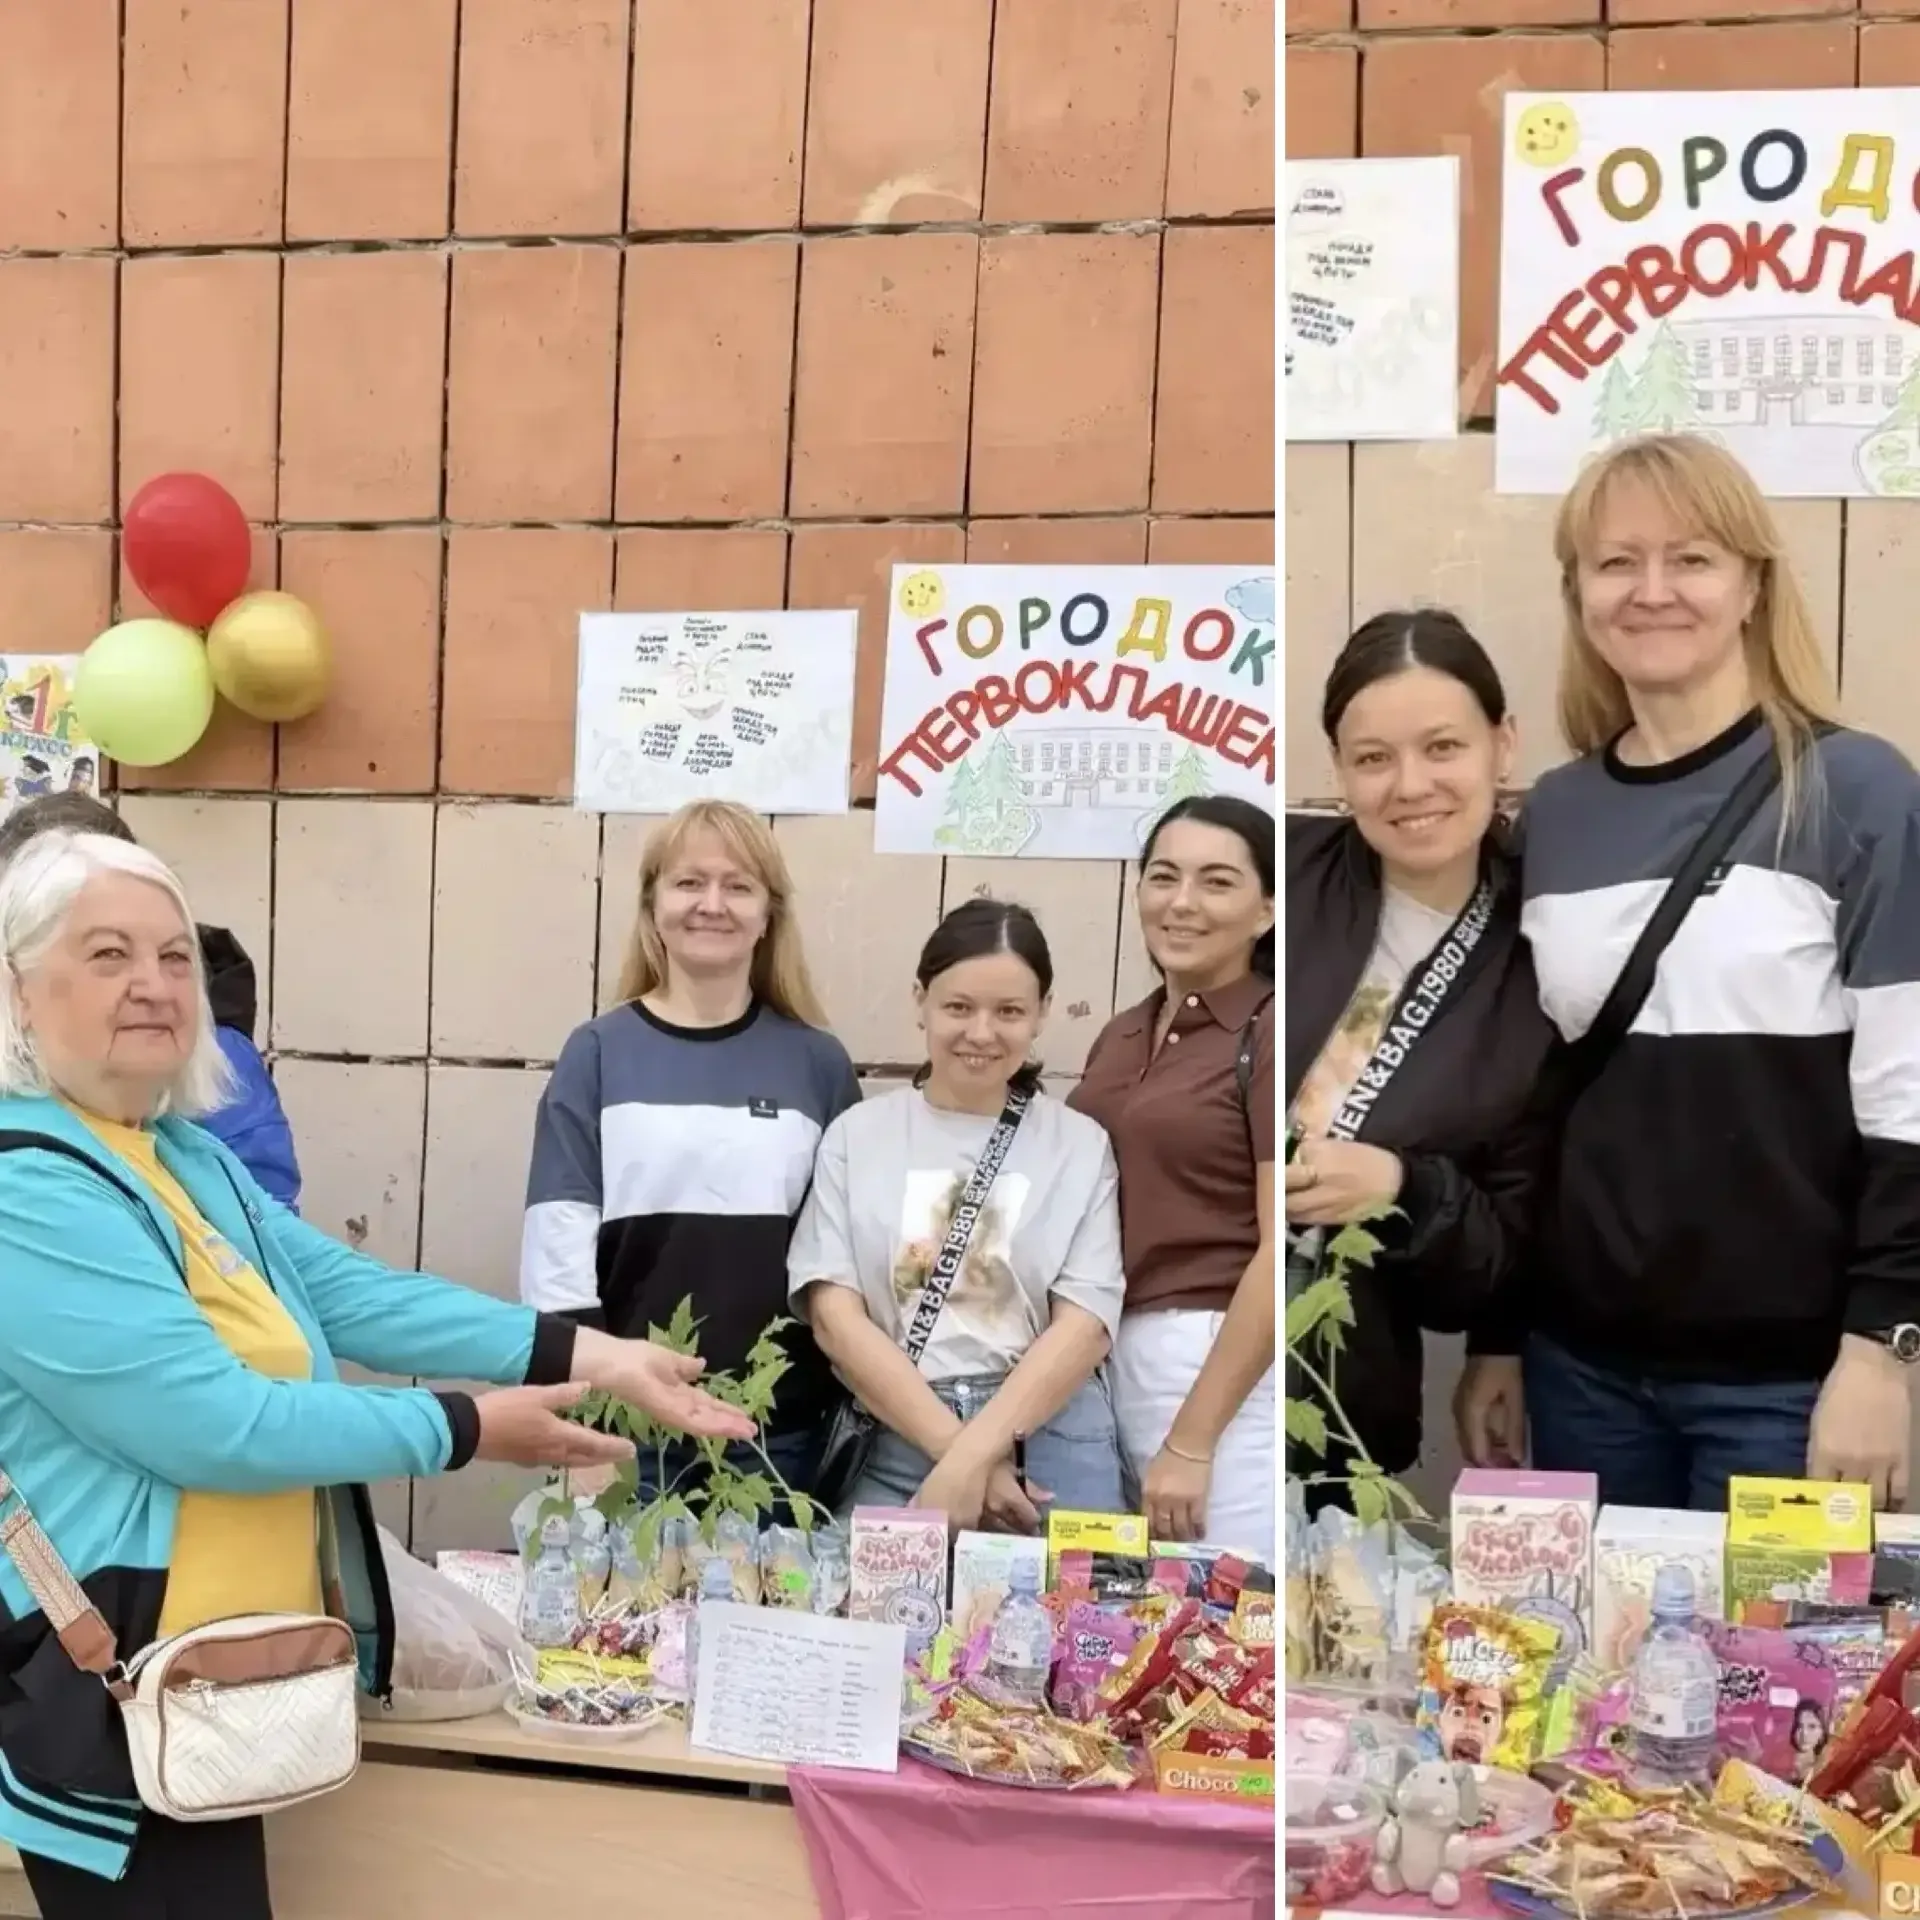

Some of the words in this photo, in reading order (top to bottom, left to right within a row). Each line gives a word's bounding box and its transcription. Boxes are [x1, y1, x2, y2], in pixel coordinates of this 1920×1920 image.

[1541, 129, 1920, 247] ГОРОД
[1500, 221, 1920, 414] ПЕРВОКЛА
[915, 592, 1275, 686] ГОРОДОК
[1165, 1768, 1238, 1793] Choco
